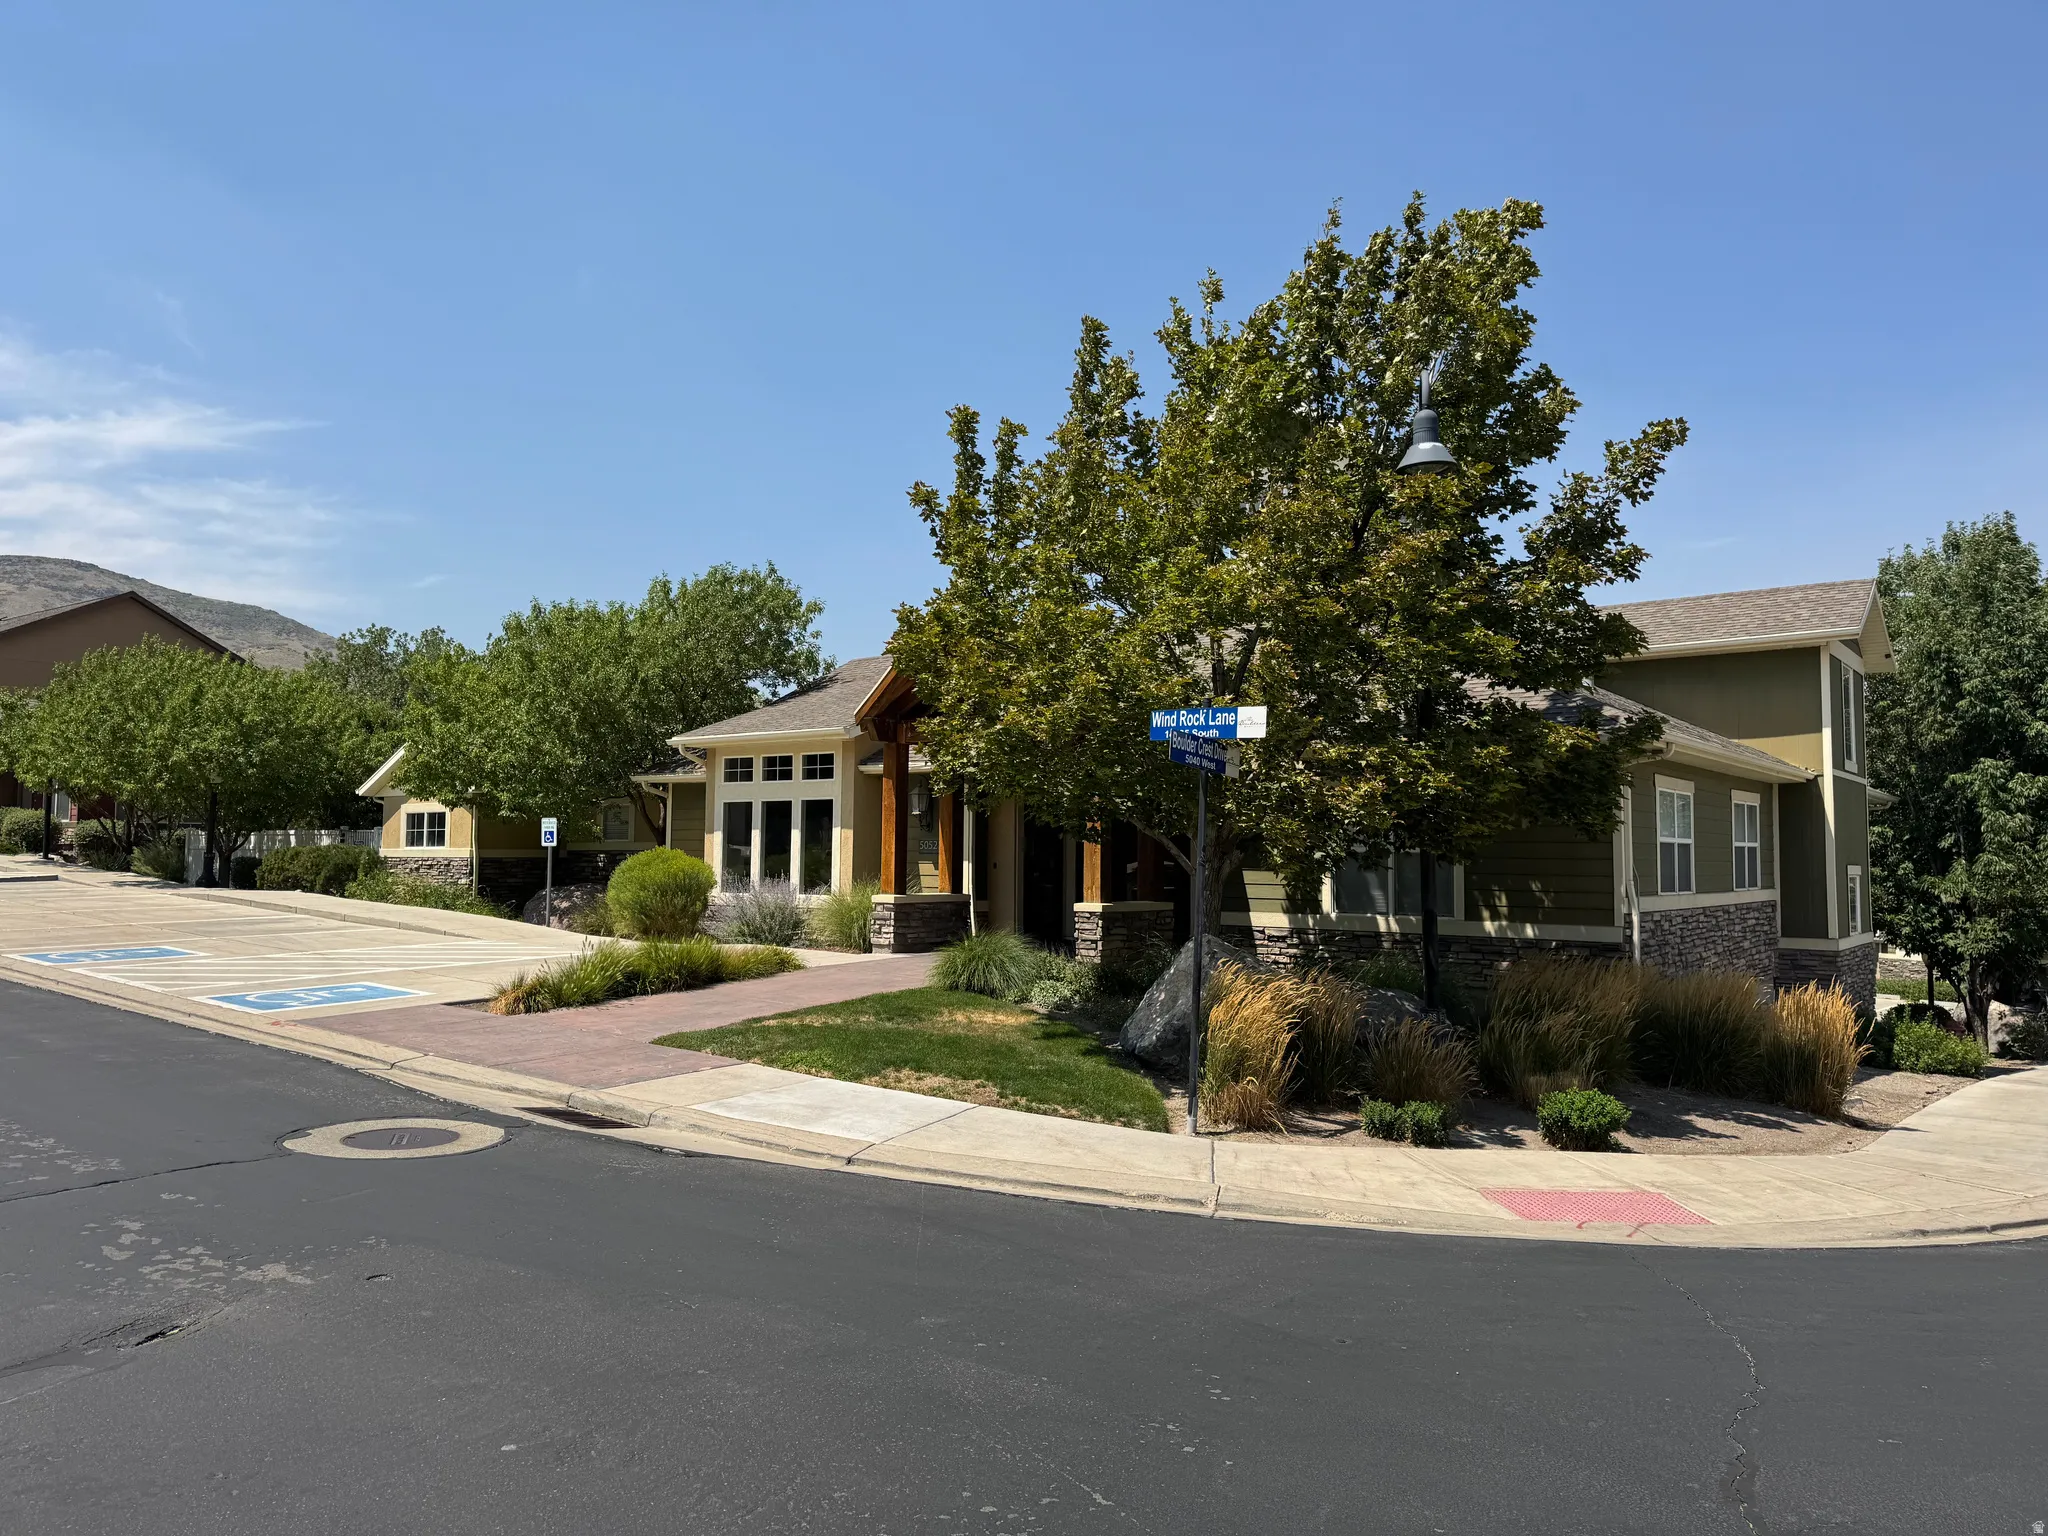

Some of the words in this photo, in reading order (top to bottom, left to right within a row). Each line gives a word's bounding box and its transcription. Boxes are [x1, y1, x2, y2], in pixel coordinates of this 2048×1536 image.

[1152, 710, 1176, 727] Wind
[1180, 709, 1205, 726] Rock
[1208, 709, 1235, 725] Lane
[1192, 728, 1219, 737] South
[1172, 731, 1197, 753] Boulder
[1198, 738, 1213, 757] Crest
[1214, 743, 1227, 762] Drive
[1185, 754, 1200, 765] 5040
[1202, 758, 1216, 770] West
[920, 841, 937, 849] 5052
